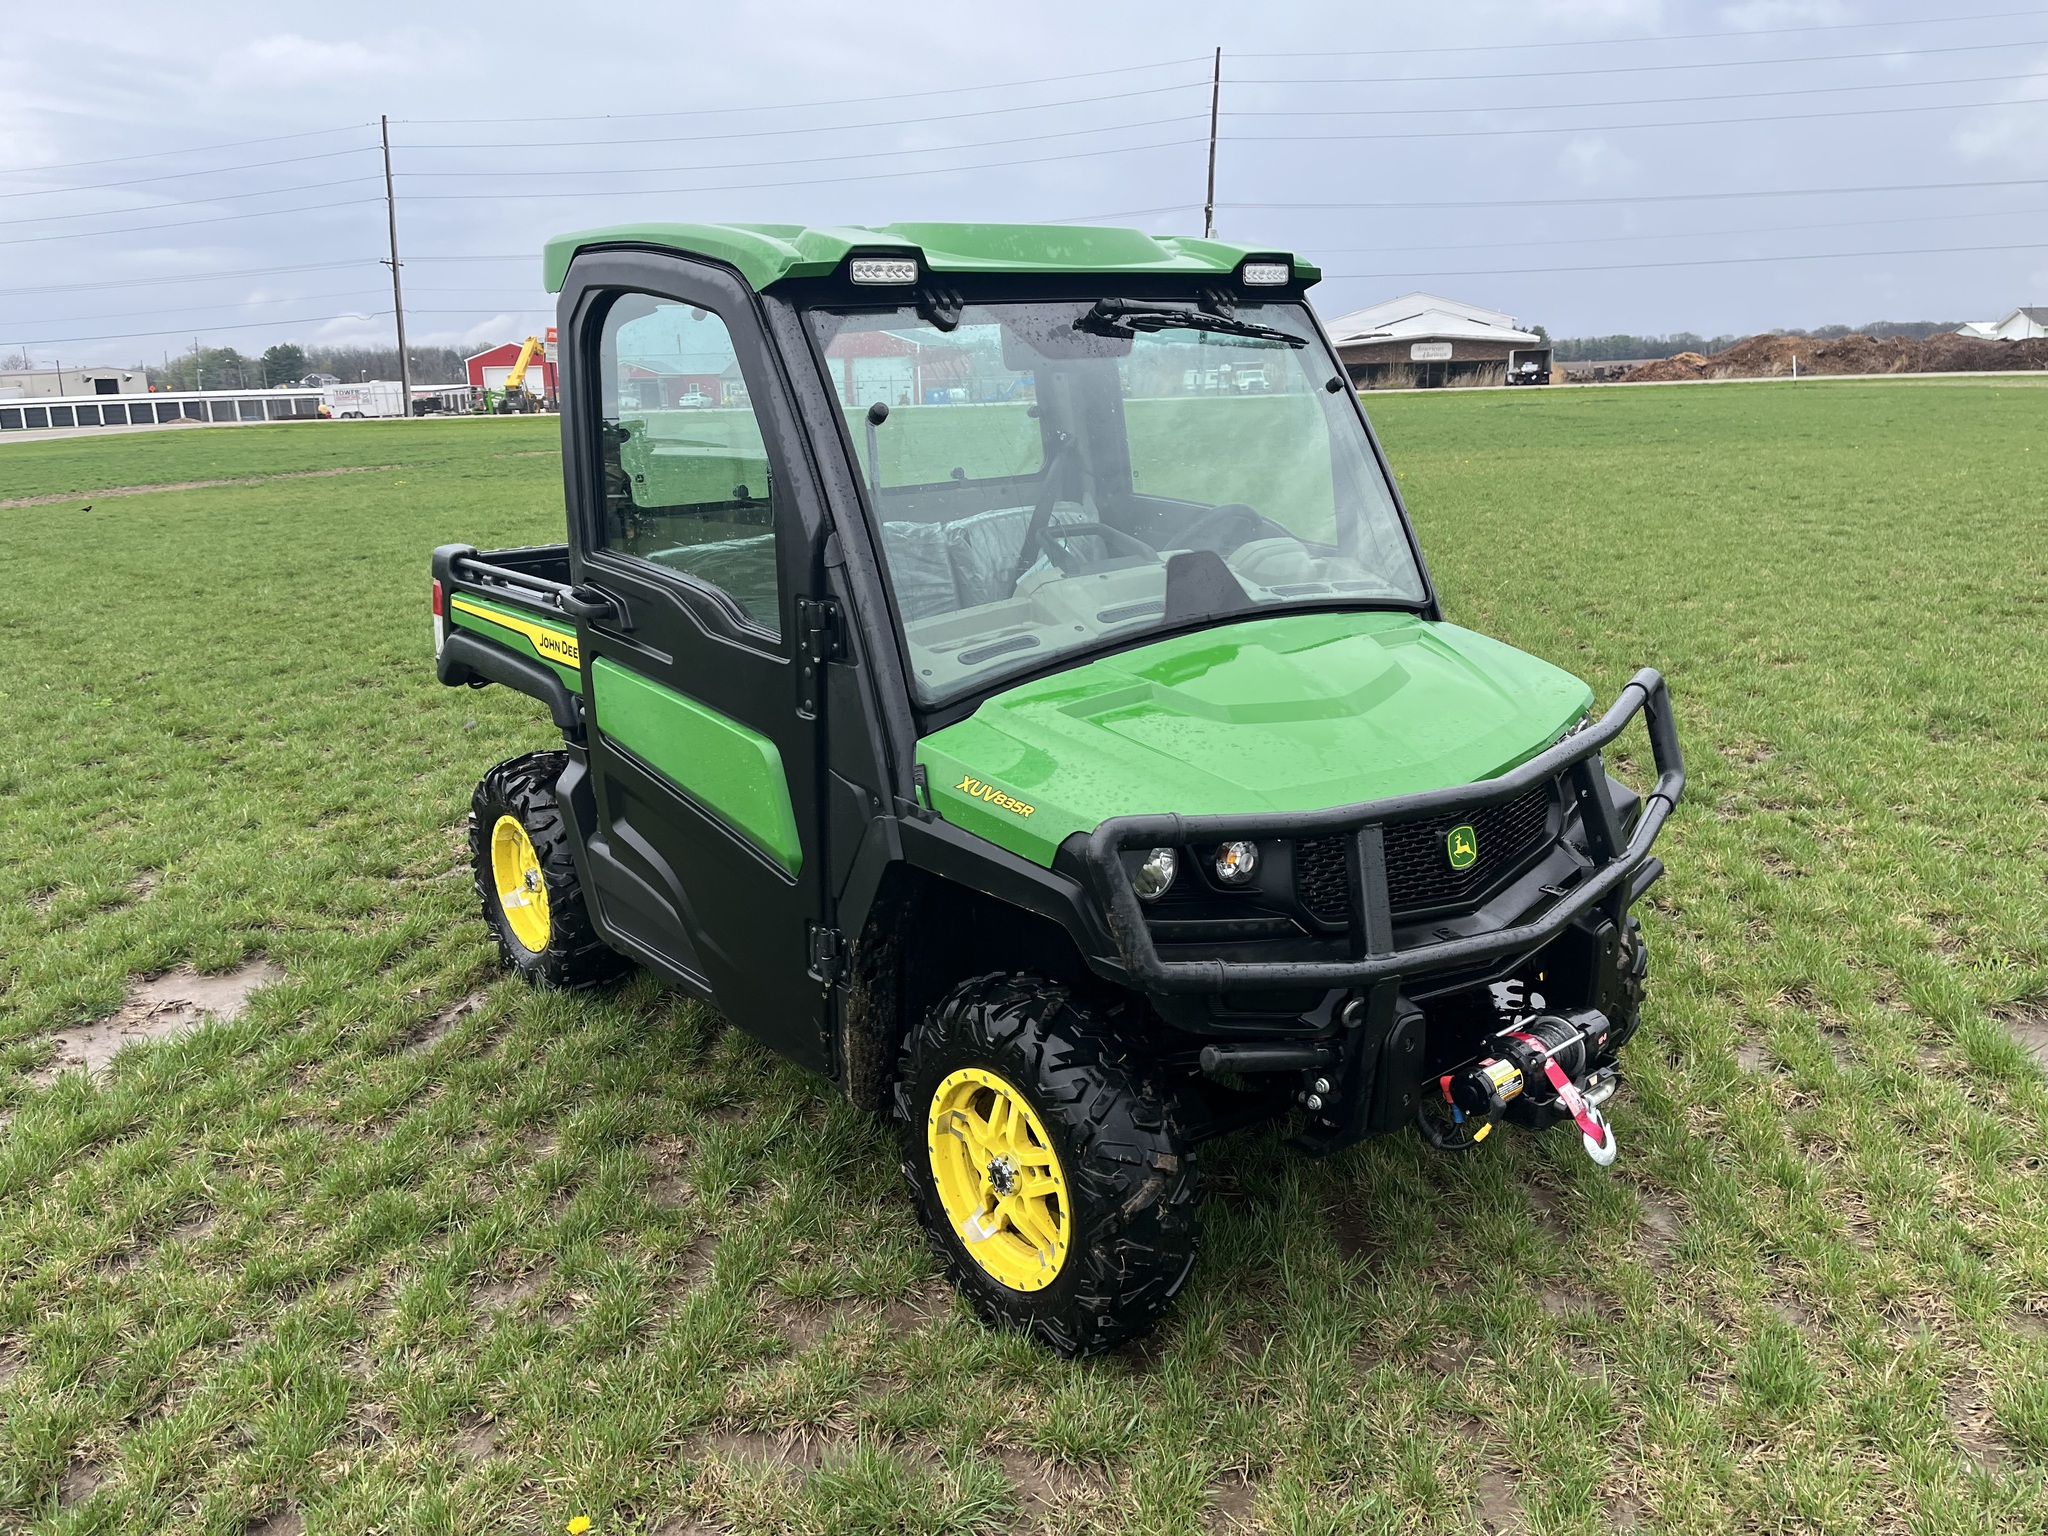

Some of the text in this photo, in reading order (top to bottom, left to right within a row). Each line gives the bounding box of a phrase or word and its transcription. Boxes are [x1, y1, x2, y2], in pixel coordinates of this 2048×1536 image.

[540, 633, 579, 659] JOHN DEE
[954, 774, 1036, 818] XUV835R
